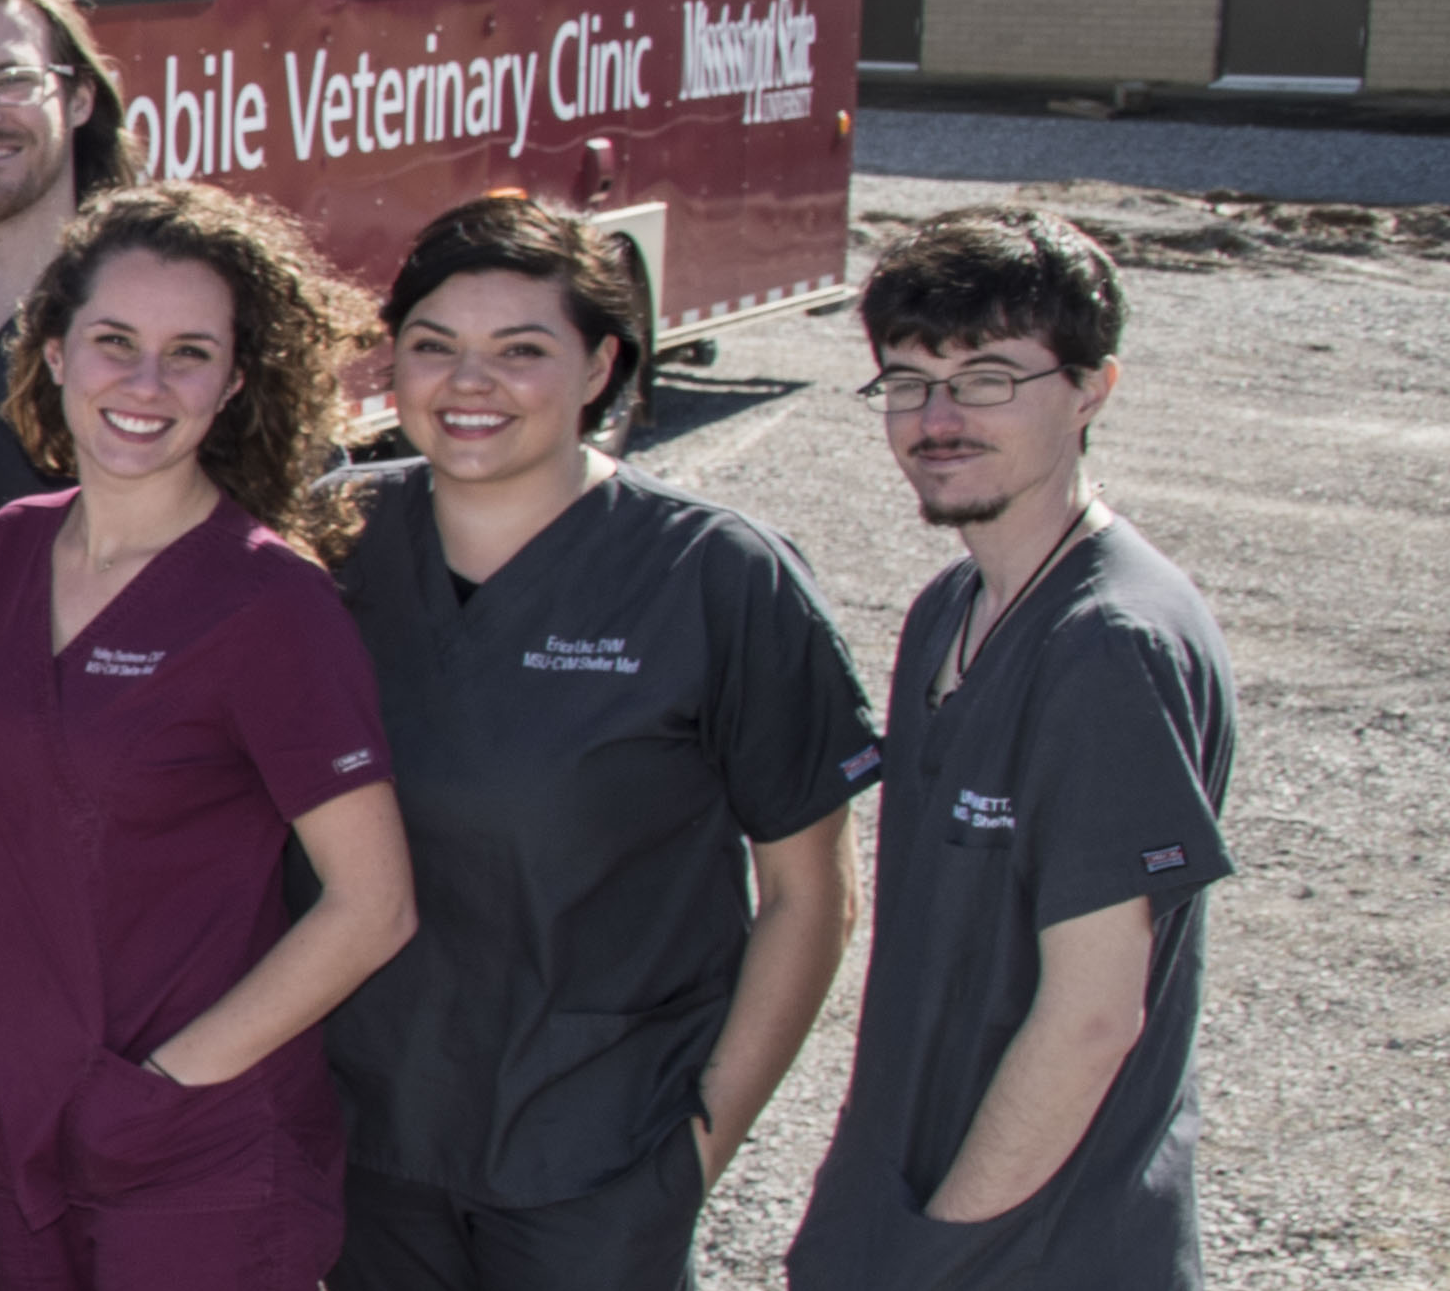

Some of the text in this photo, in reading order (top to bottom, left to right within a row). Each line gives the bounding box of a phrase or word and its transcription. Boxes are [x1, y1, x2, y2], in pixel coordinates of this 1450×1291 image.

[123, 10, 652, 182] obile Veterinary Clinic
[679, 0, 777, 125] Mississippi
